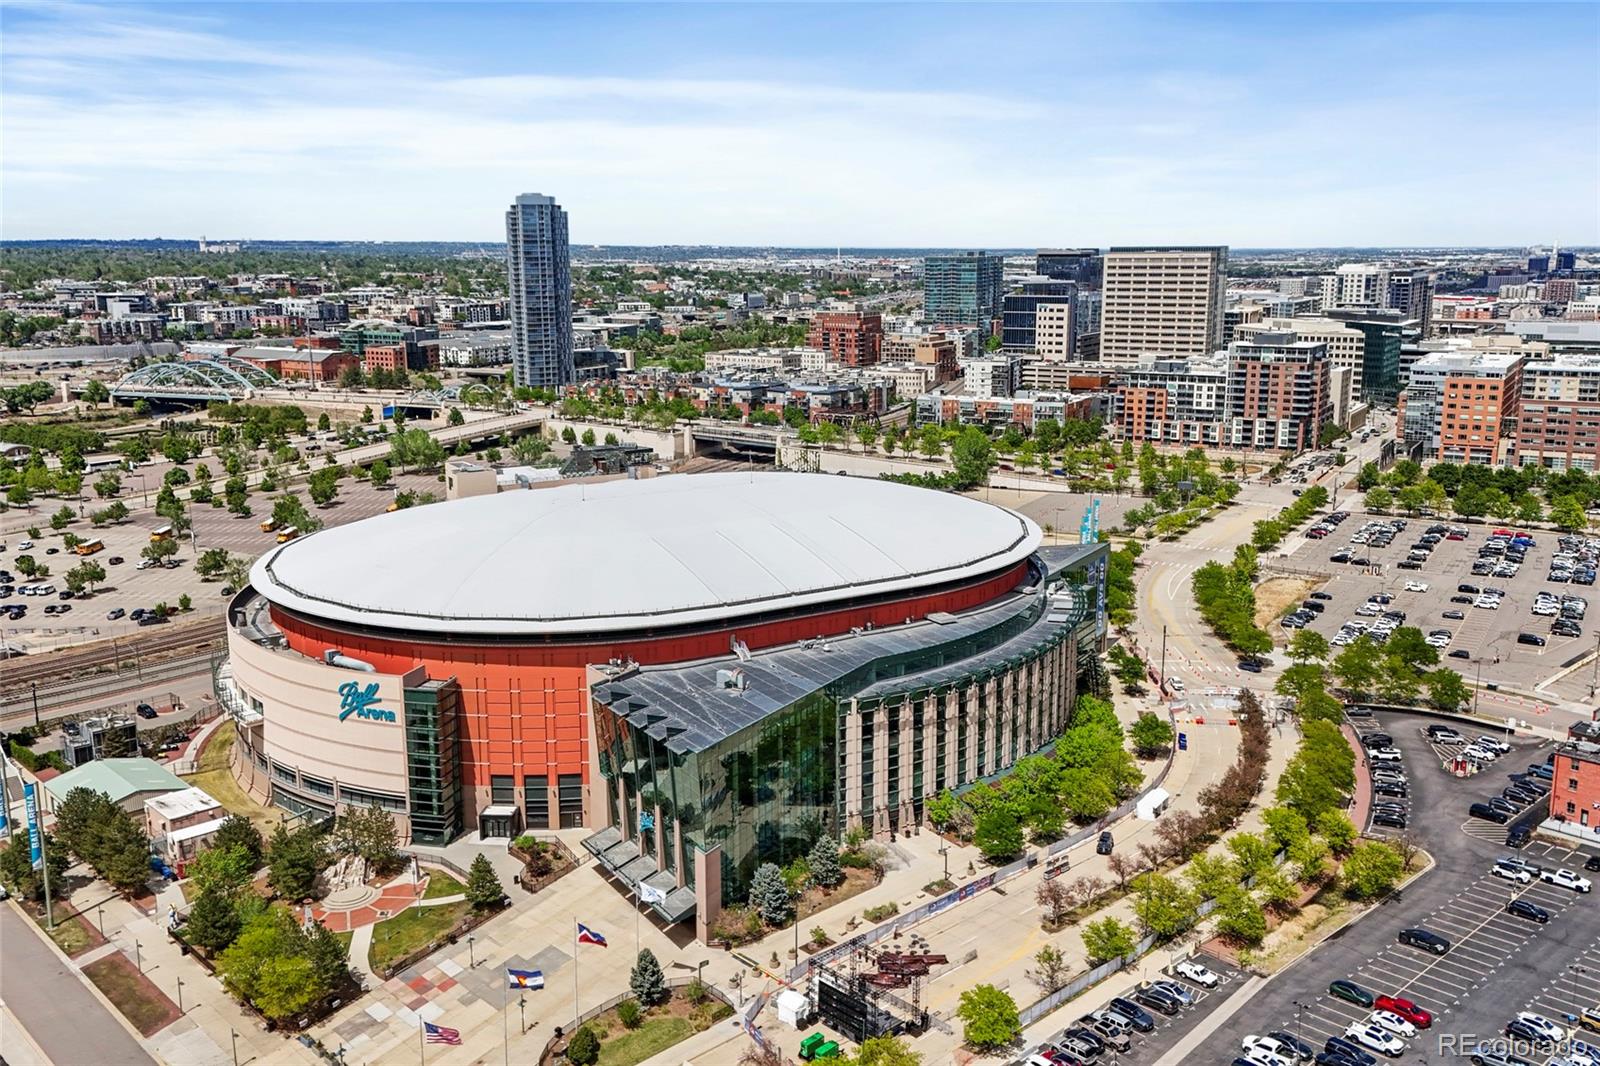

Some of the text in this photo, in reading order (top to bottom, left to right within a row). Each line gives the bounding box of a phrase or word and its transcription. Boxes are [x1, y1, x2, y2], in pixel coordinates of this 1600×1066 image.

[338, 681, 382, 722] Ball
[357, 706, 396, 722] Arena
[26, 794, 40, 849] BALL ARENA
